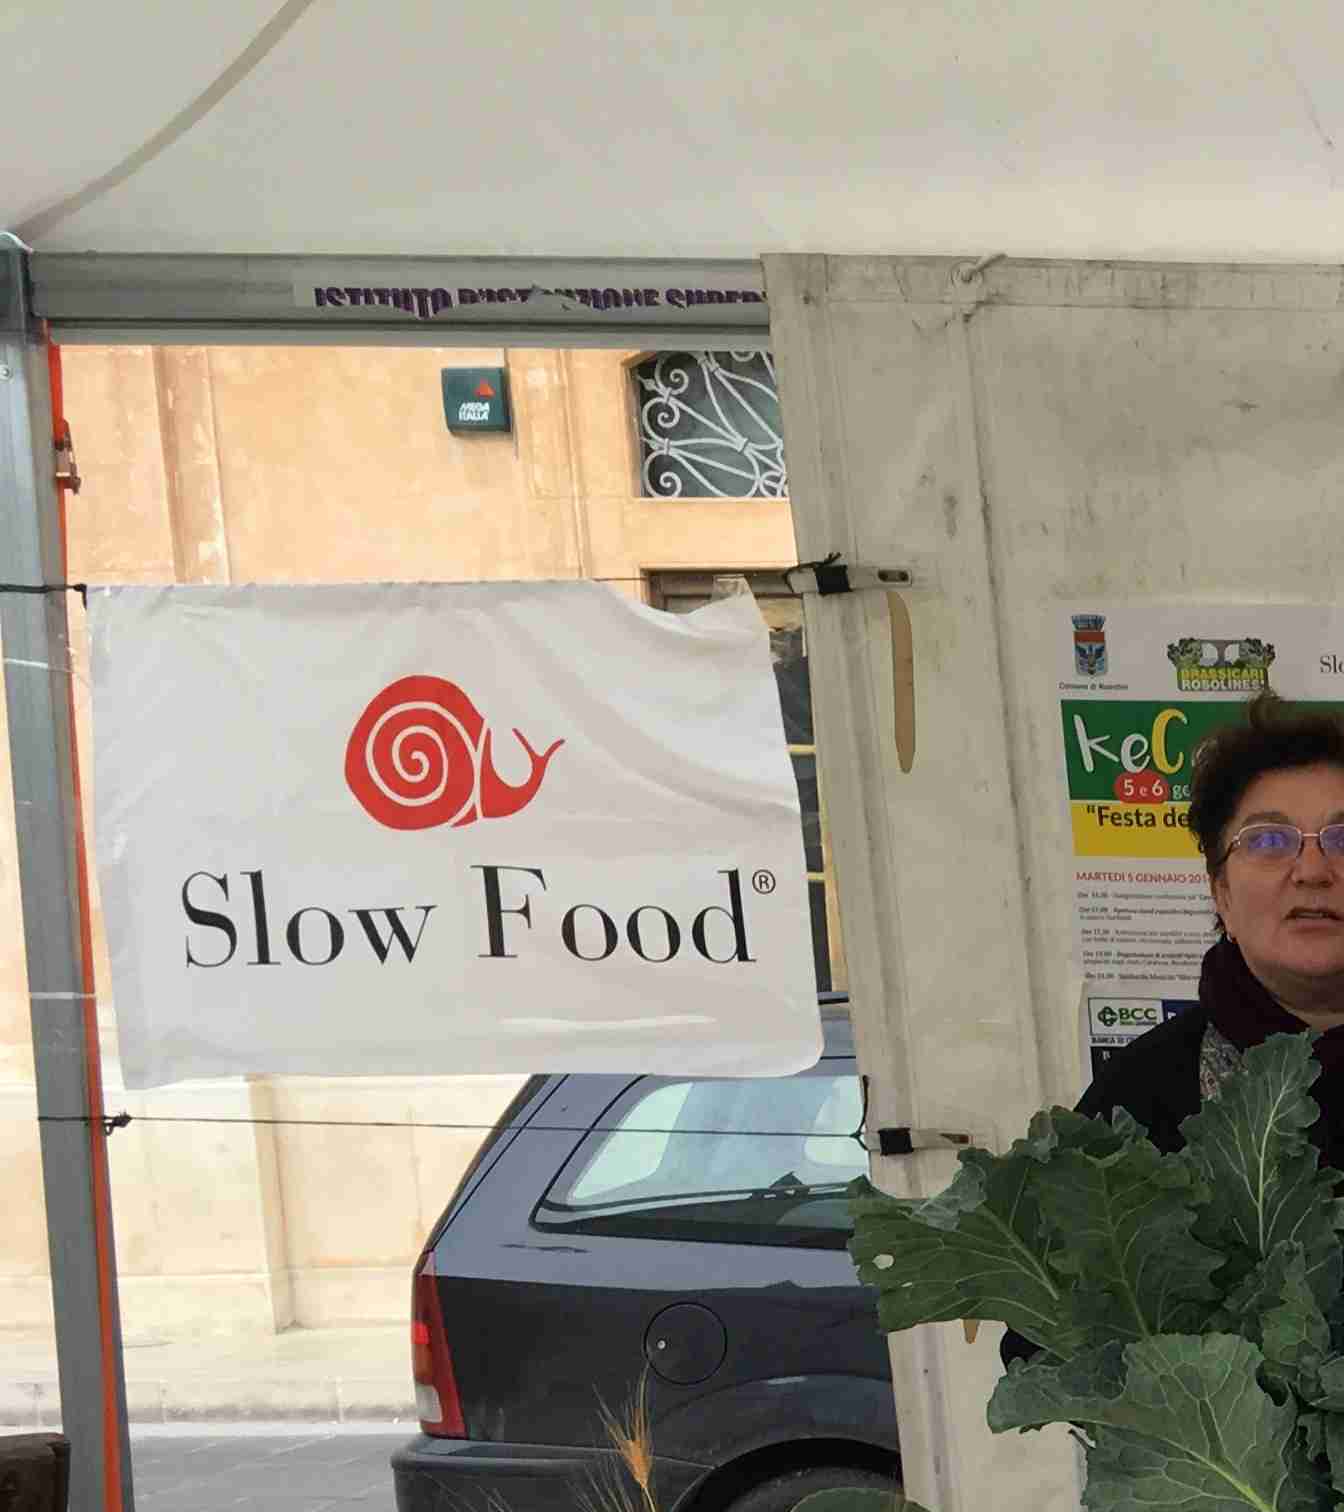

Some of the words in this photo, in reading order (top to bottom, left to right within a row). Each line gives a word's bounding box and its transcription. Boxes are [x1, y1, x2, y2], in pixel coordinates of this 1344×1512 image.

[1123, 779, 1134, 797] 5
[1139, 785, 1149, 797] e
[1151, 778, 1164, 797] 6
[1162, 805, 1192, 828] de
[181, 868, 439, 968] Slow
[1117, 1007, 1158, 1021] BCC
